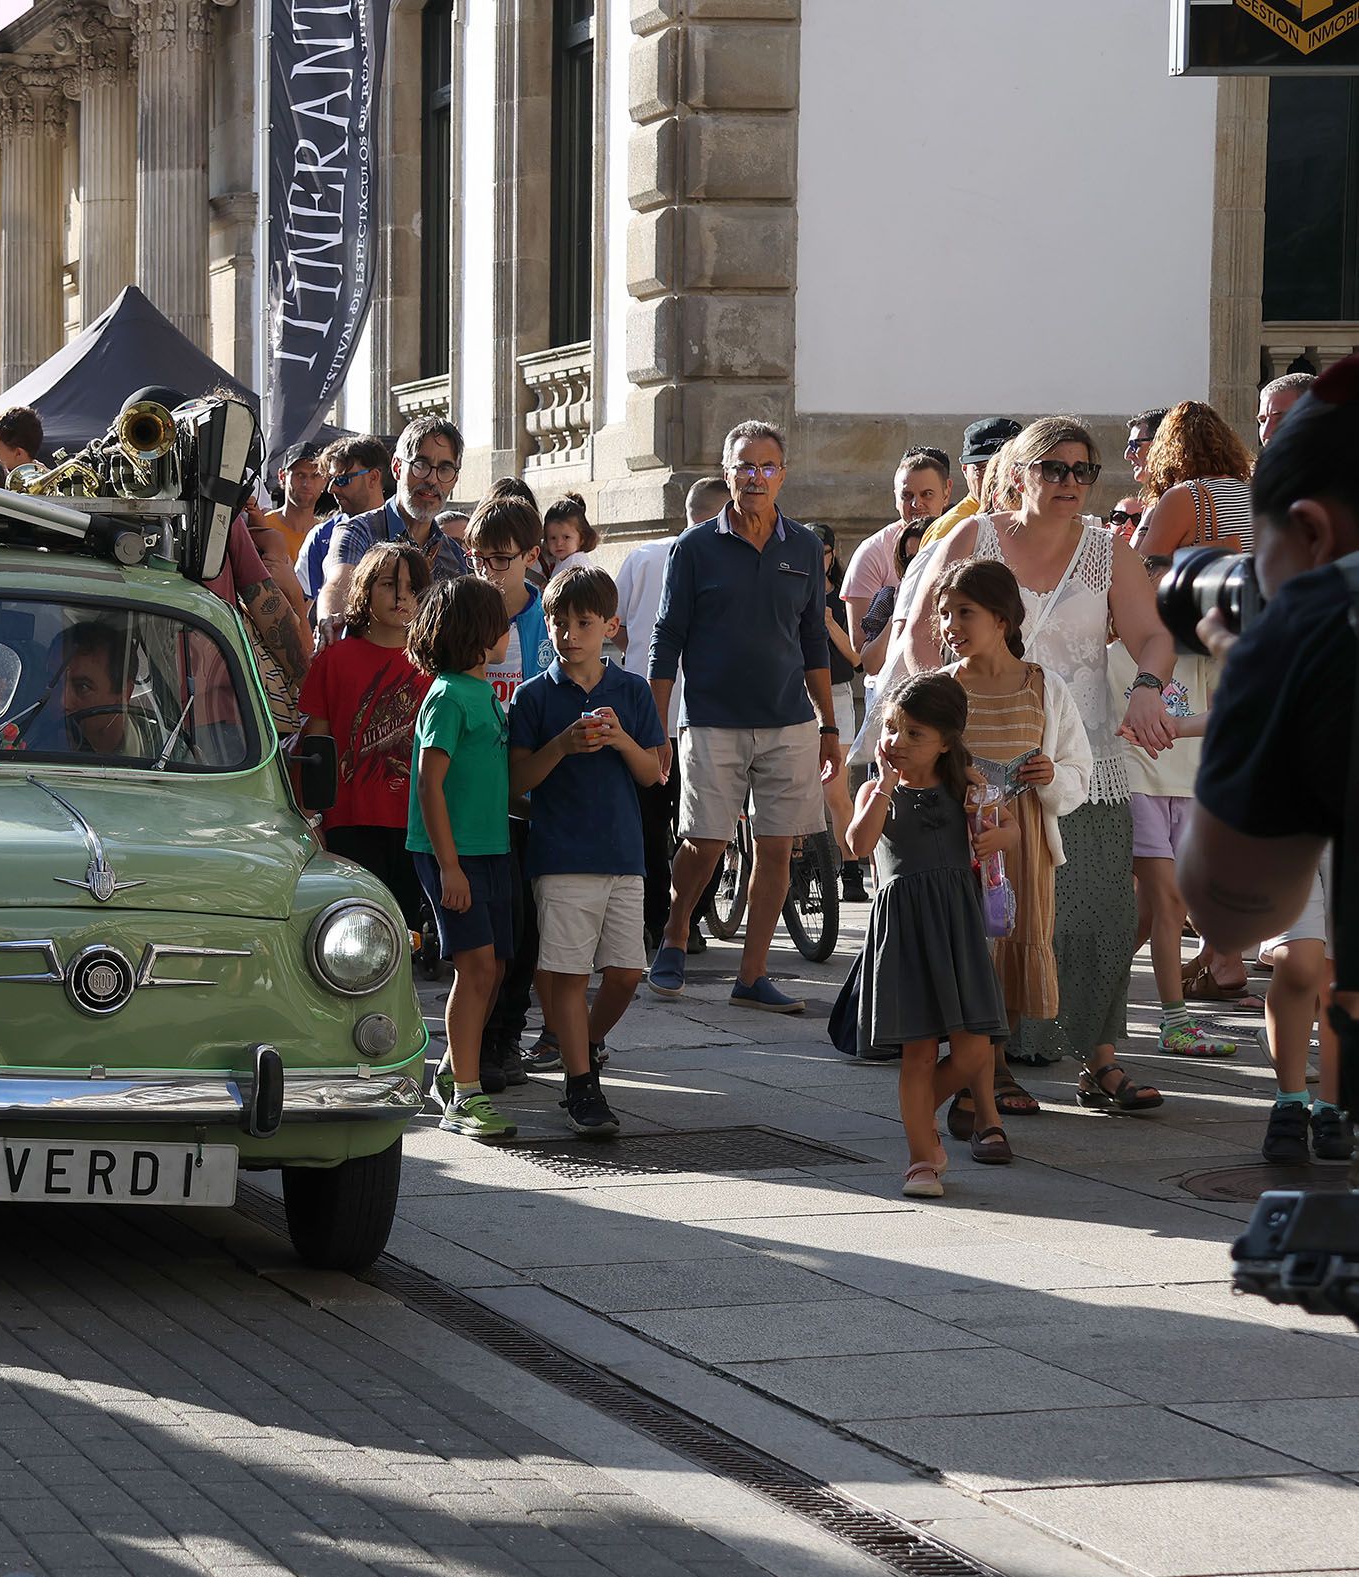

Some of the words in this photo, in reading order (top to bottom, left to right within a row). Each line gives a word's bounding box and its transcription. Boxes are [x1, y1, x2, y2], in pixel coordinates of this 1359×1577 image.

[1308, 5, 1359, 49] INMOBI
[356, 136, 370, 283] ESPECTÁCULOS
[350, 287, 363, 315] DE
[491, 680, 523, 703] OI
[93, 972, 113, 989] 600
[4, 1147, 193, 1198] VERDI
